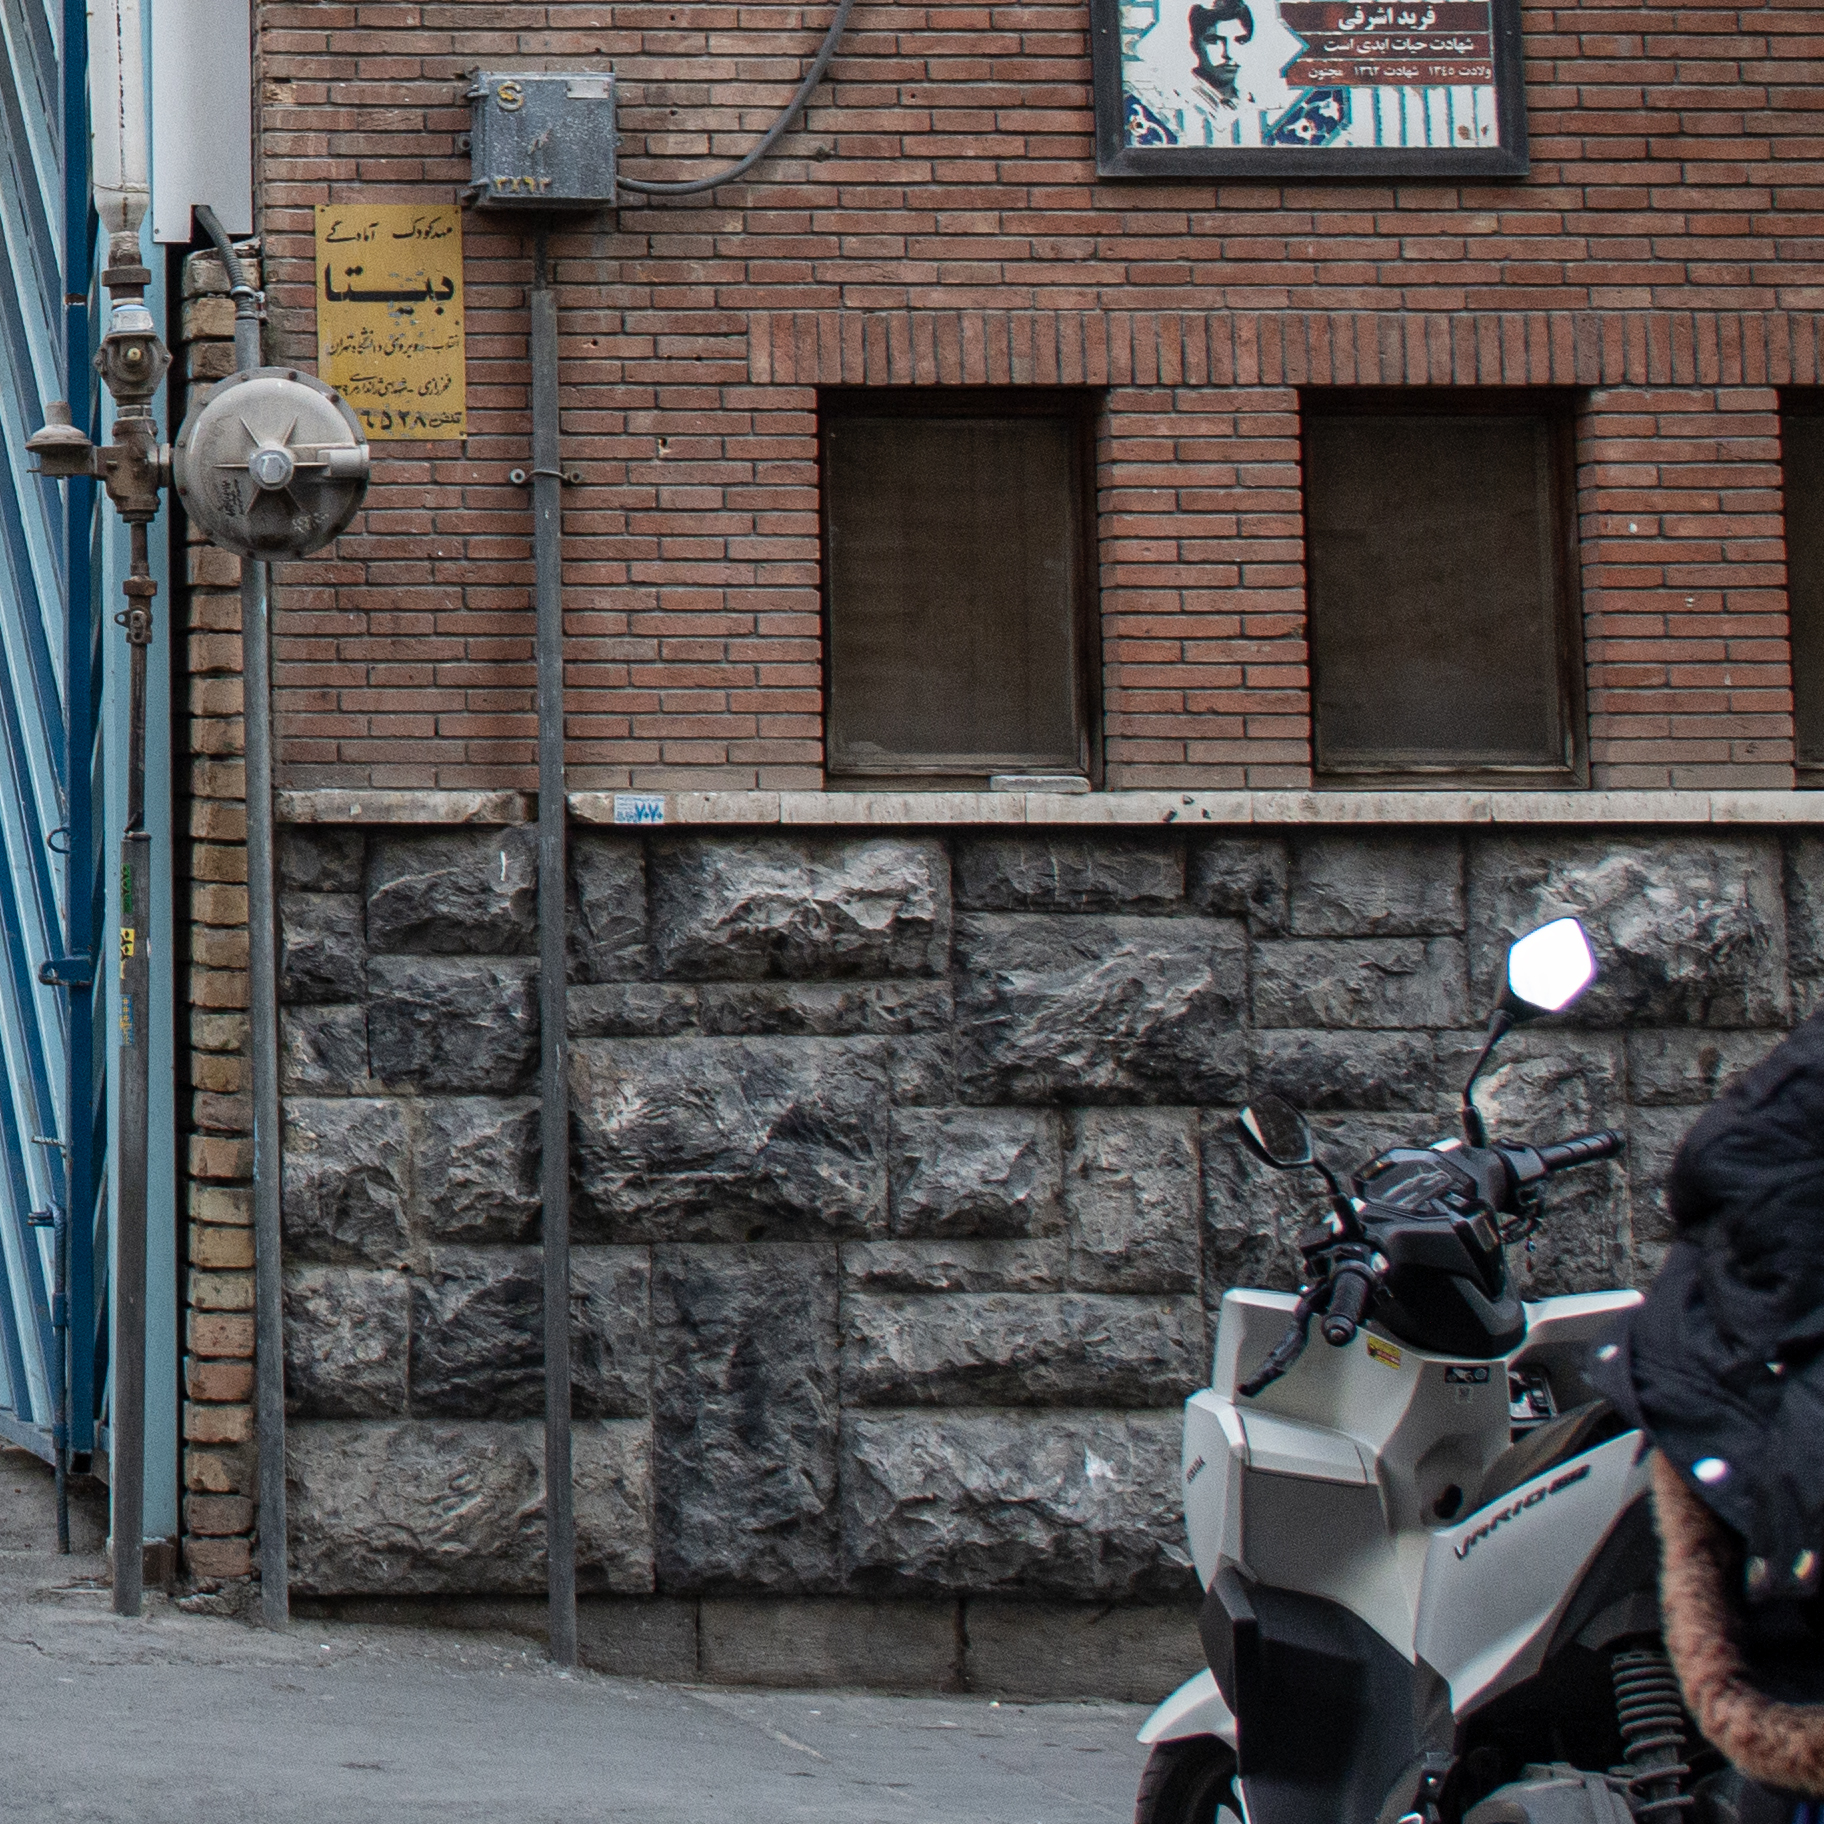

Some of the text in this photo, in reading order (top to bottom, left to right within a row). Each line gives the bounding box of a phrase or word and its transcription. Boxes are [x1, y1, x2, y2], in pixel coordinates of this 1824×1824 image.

[1337, 5, 1437, 31] فرید اشرفی
[1323, 37, 1474, 54] شهادت حیات ابدی است
[1307, 66, 1344, 81] مجنون
[1383, 66, 1420, 79] شهادت
[1458, 65, 1492, 79] ولادت
[324, 262, 455, 316] بیتا
